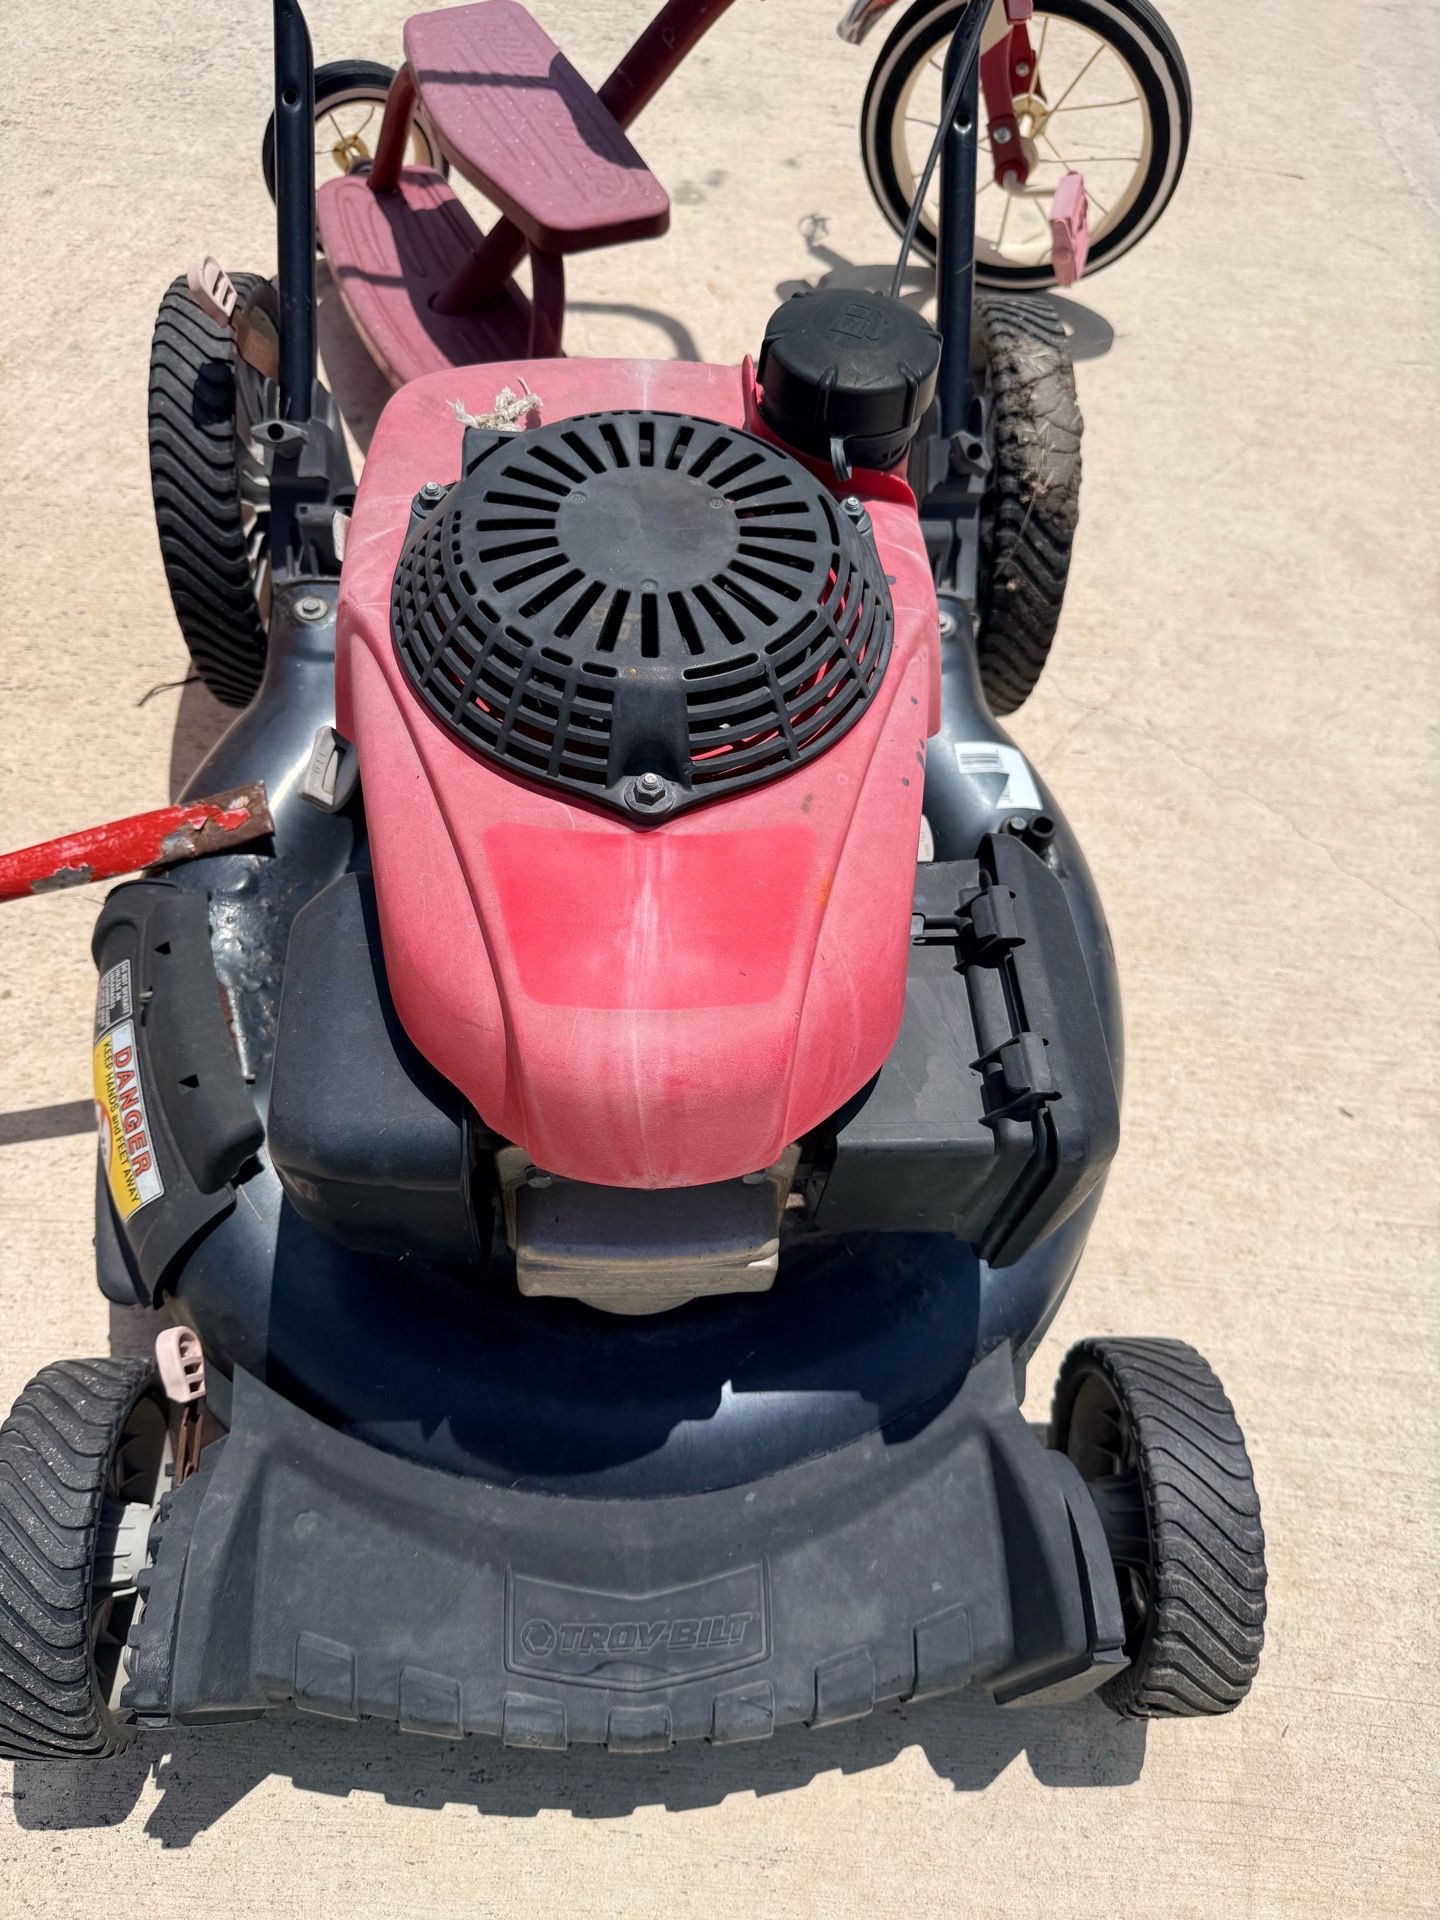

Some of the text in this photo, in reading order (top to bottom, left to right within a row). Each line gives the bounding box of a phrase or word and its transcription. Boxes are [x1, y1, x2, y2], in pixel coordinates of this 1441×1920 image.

[104, 1042, 113, 1070] KEEP
[105, 1072, 119, 1112] HANDS
[112, 1114, 122, 1135] and
[113, 1045, 152, 1177] DANGER
[116, 1136, 129, 1165] FEET
[123, 1168, 140, 1202] AWAY
